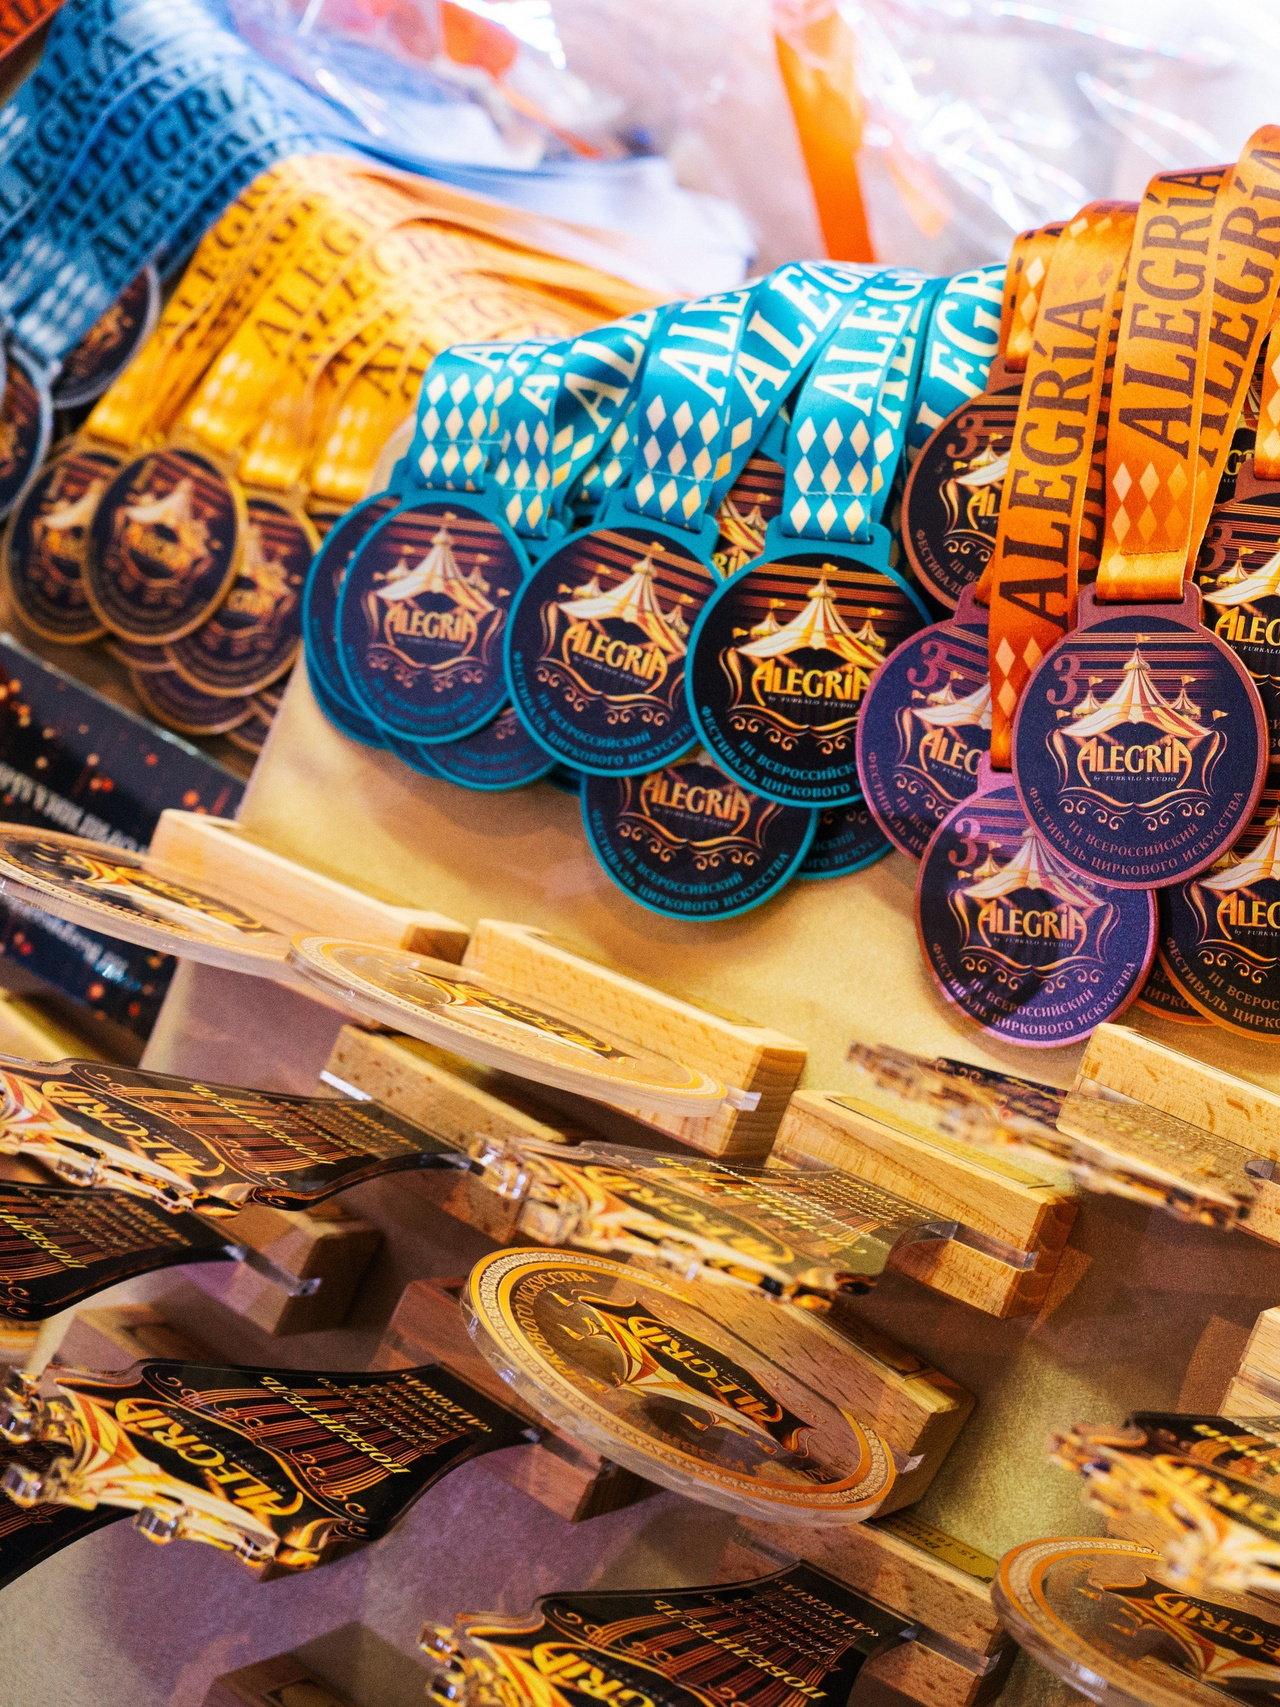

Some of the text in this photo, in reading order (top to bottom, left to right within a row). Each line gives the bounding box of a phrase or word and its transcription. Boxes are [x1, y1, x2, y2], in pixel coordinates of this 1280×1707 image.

[946, 413, 984, 458] 3
[1199, 522, 1233, 572] 3
[907, 640, 948, 687] 3
[1046, 654, 1082, 706] 3
[701, 706, 850, 799] ФЕСТИВАЛЬ ЦИРКОВОГО
[740, 741, 756, 757] III
[948, 817, 981, 867] 3
[1029, 787, 1245, 876] ФЕСТИВАЛЬ ЦИРКОВОГО ИСКУССТВА
[1067, 819, 1199, 858] III ВСЕРОССИЙСКИЙ
[932, 942, 1136, 1035] ФЕСТИВАЛЬ ЦИРКОВОГО ИСКУССТВА
[1166, 936, 1228, 1012] ФЕСТИВАЛЬ
[1208, 971, 1225, 989] III
[986, 989, 1095, 1018] ВСЕРОССИЙСКИЙ
[260, 1375, 411, 1475] ПОБЕДИТЕЛЬ
[653, 1599, 828, 1700] ПОБЕДИТЕЛЬ
